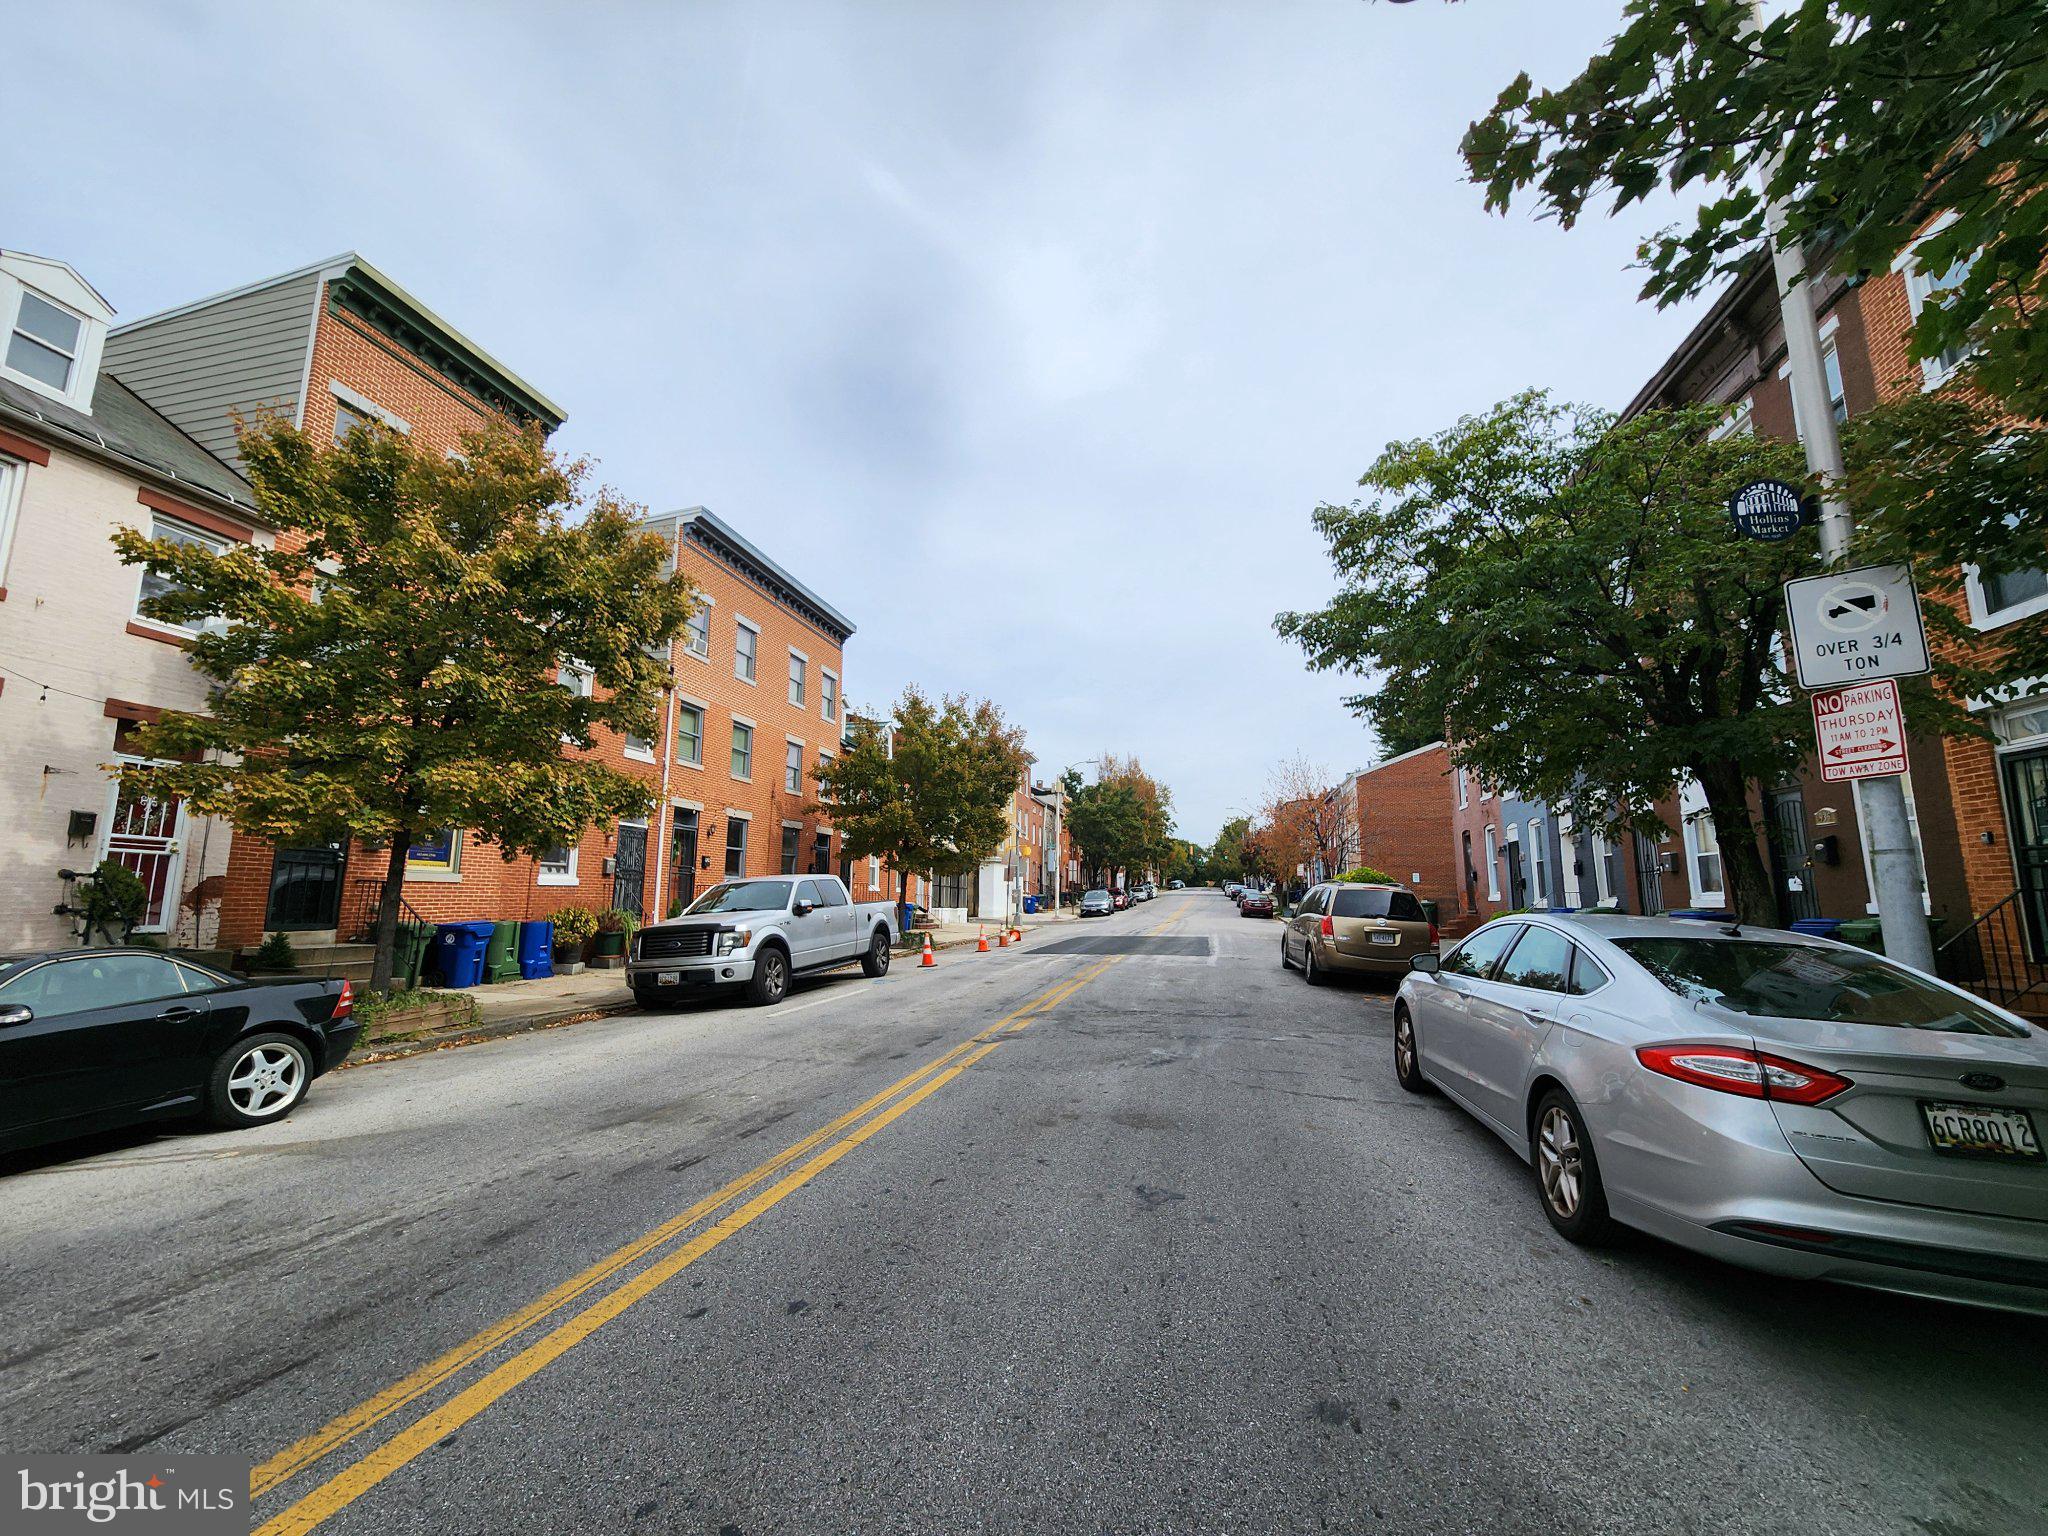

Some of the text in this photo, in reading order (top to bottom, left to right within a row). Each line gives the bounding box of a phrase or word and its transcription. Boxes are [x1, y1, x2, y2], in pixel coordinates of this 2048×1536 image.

[1750, 514, 1789, 525] Hollins
[1751, 524, 1789, 534] Market
[1816, 632, 1902, 657] OVER 3/4
[1844, 655, 1880, 671] TON
[1816, 687, 1891, 714] NO PARKING
[1821, 708, 1894, 730] THURSDAY
[1855, 729, 1866, 739] TO
[1835, 743, 1888, 756] STREET CLEANING
[1827, 760, 1902, 777] TOW AWAY ZONE
[1933, 1115, 2035, 1149] 6CR8012
